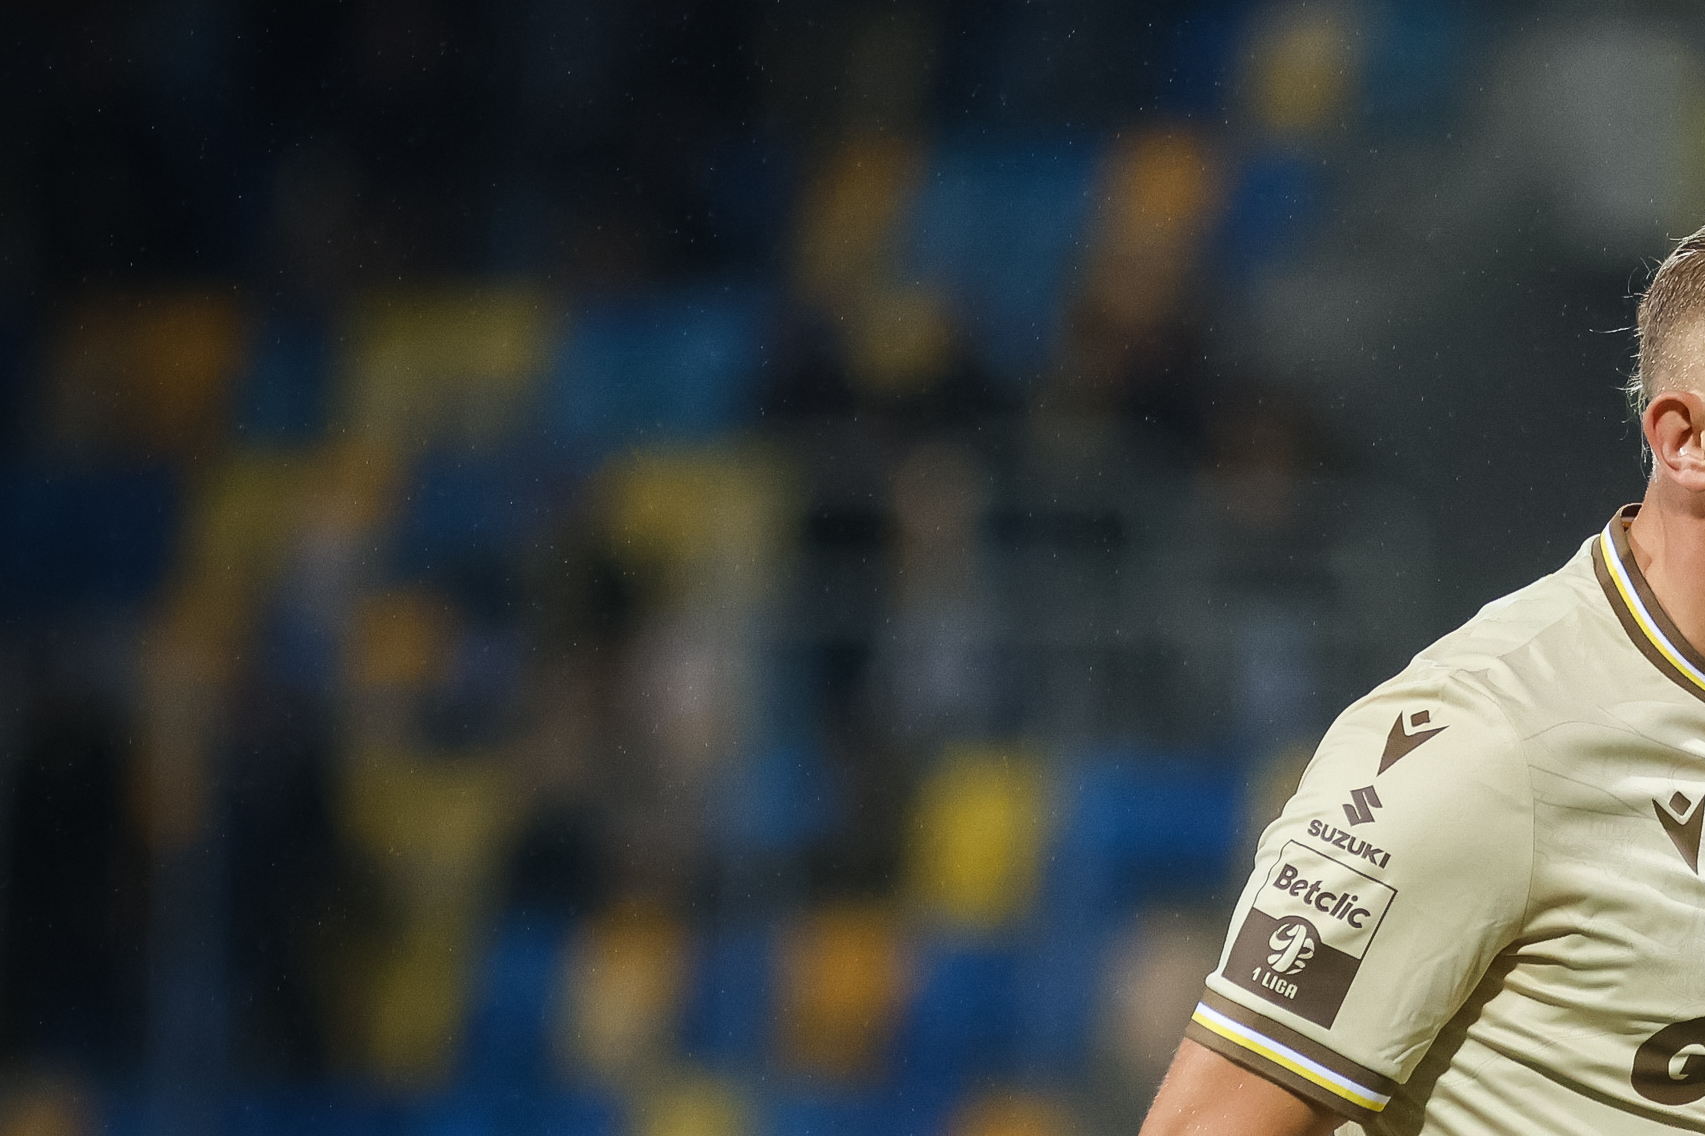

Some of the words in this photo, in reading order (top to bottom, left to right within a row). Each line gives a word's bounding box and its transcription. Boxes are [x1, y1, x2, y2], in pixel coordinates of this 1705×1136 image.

[1307, 819, 1391, 869] SUZUKI
[1273, 863, 1371, 929] Betclic
[1262, 975, 1298, 1000] LIGA
